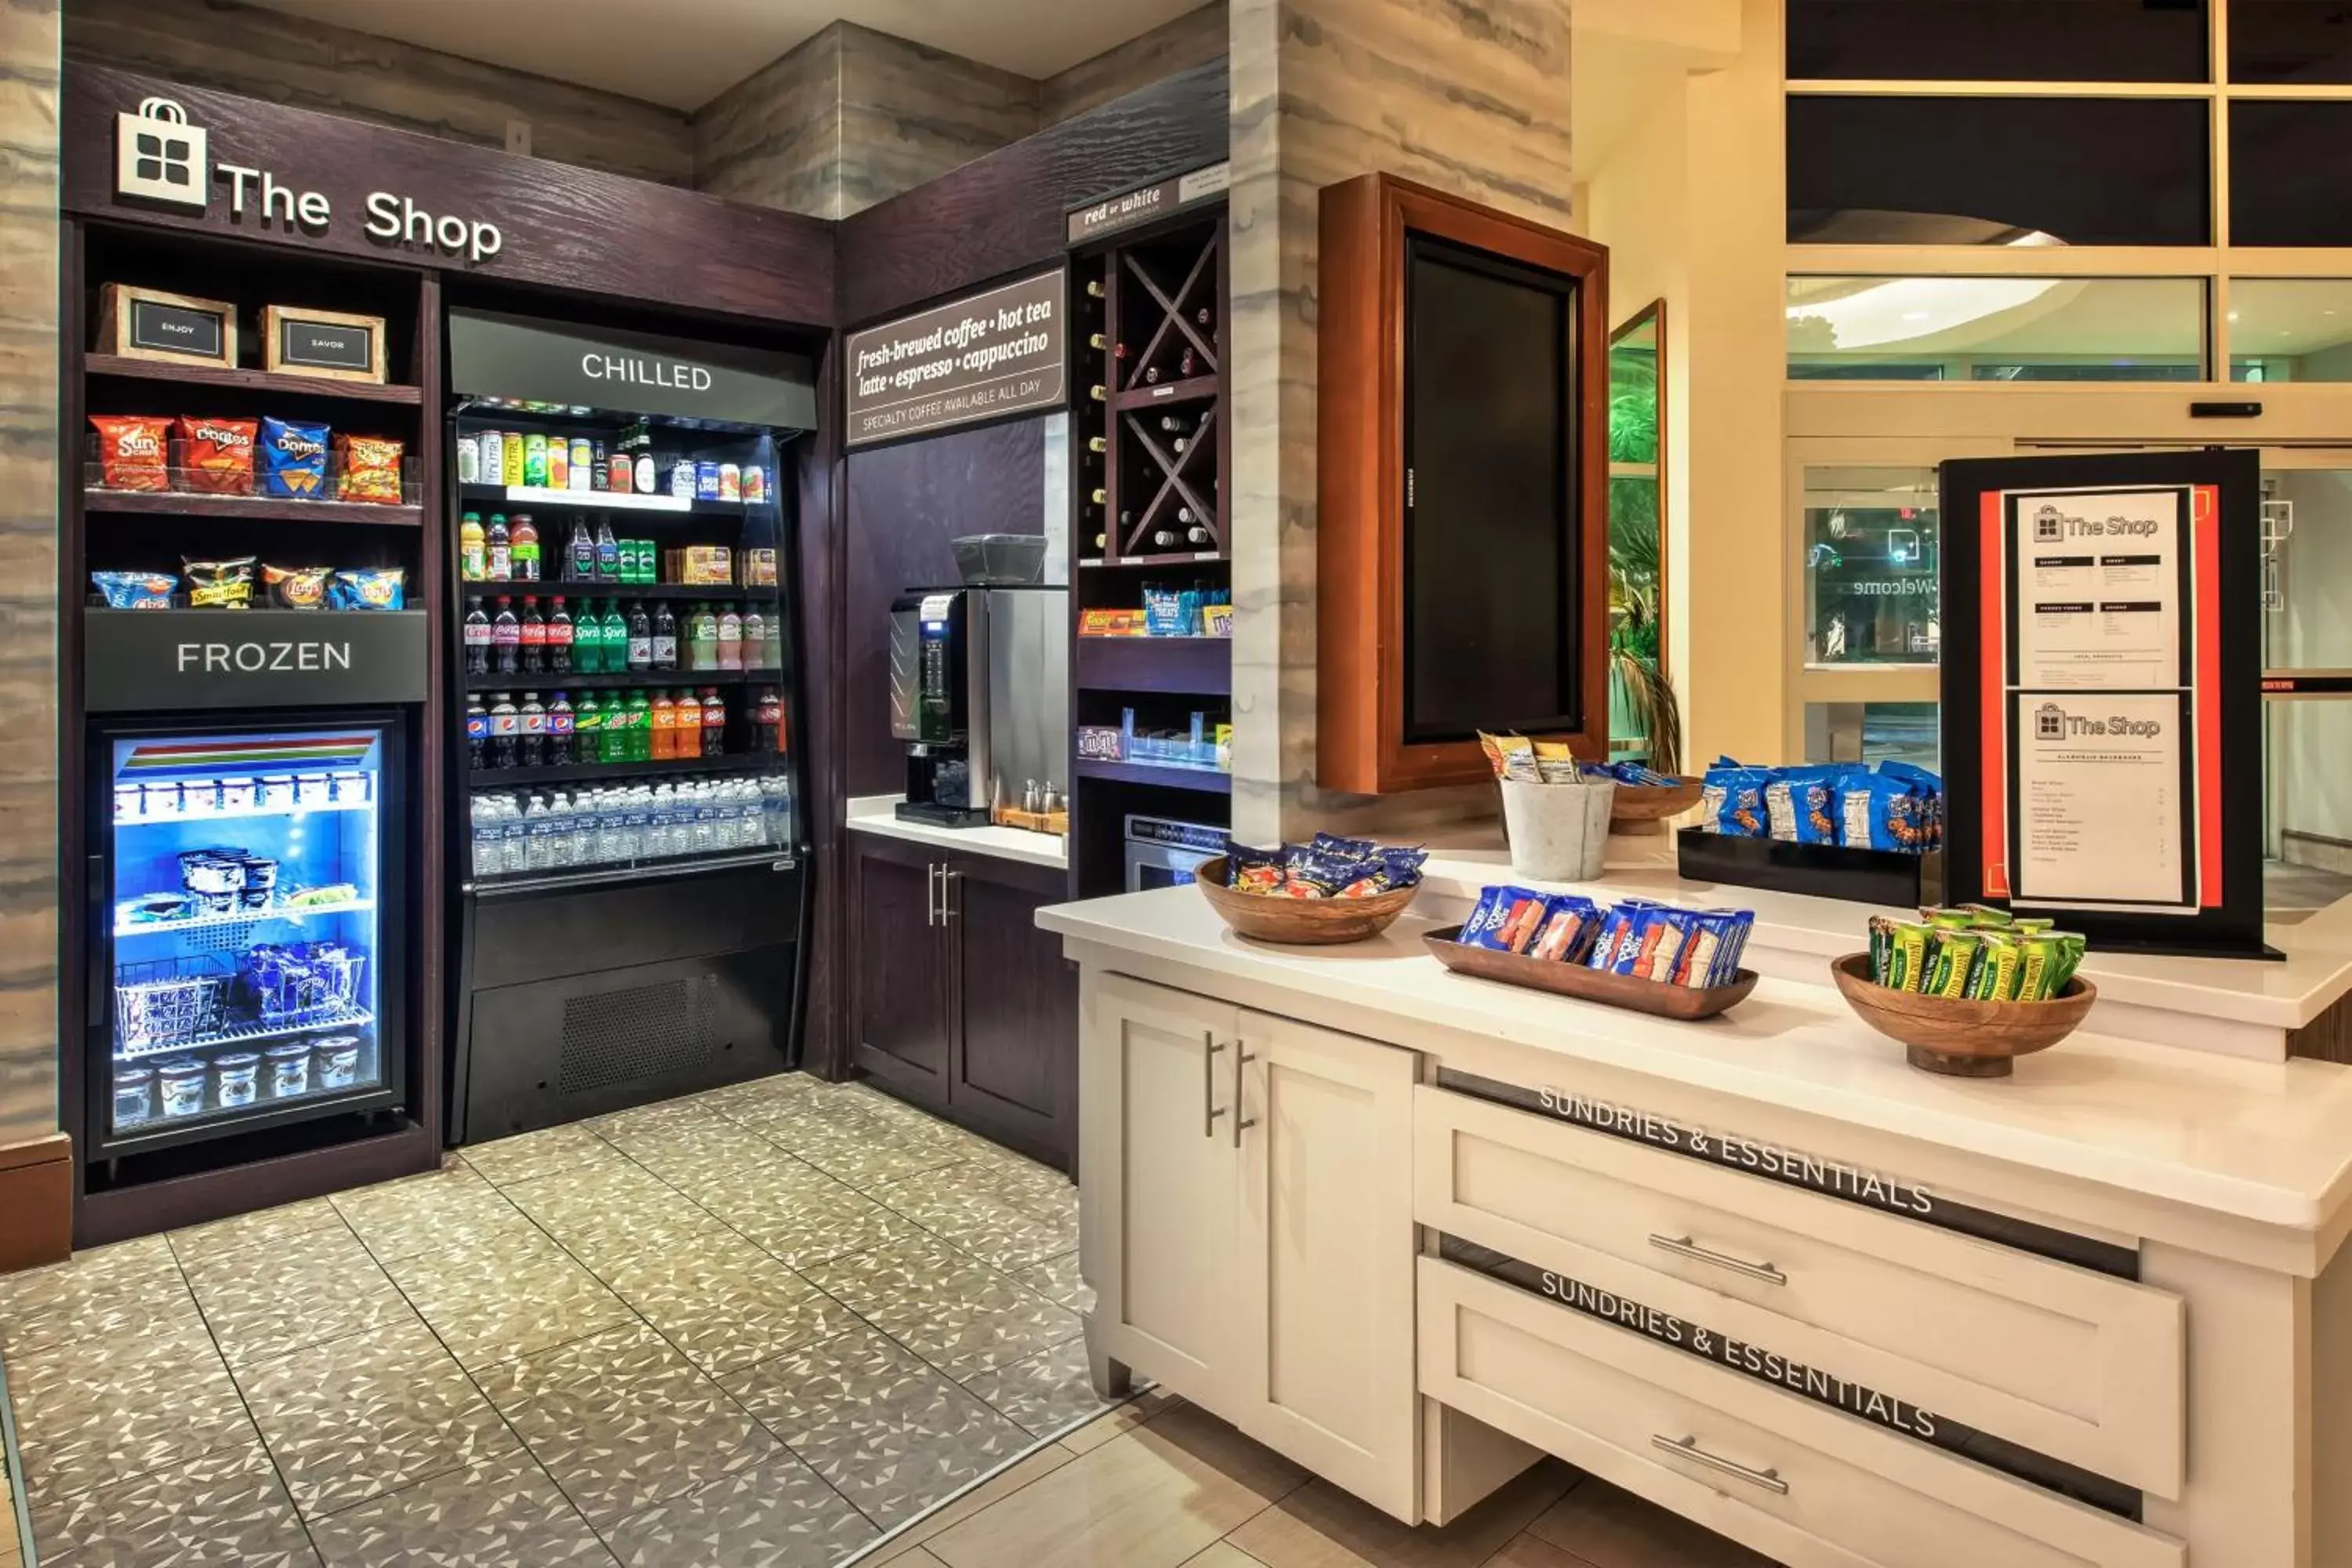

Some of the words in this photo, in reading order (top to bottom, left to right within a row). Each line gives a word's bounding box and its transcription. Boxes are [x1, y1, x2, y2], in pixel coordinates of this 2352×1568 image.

[215, 163, 330, 226] The
[365, 191, 503, 261] Shop
[1084, 203, 1106, 225] red
[1109, 205, 1118, 214] or
[1121, 188, 1161, 213] white
[161, 321, 194, 336] ENJOY
[311, 338, 345, 350] SAVOR
[857, 327, 942, 376] fresh-brewed
[943, 318, 986, 348] coffee
[997, 307, 1023, 332] hot
[1026, 300, 1051, 321] tea
[582, 353, 712, 390] CHILLED
[859, 375, 887, 397] latte
[895, 358, 953, 389] espresso
[963, 332, 1048, 373] cappuccino
[863, 408, 907, 431] SPECIALTY
[909, 401, 941, 421] COFFEE
[945, 389, 995, 412] AVAILABLE
[999, 385, 1017, 402] ALL
[1020, 379, 1041, 396] DAY
[118, 435, 158, 457] Sun
[2065, 517, 2103, 536] The
[2106, 516, 2158, 538] Shop
[177, 641, 351, 672] FROZEN
[2067, 715, 2106, 736] The
[2107, 716, 2161, 739] Shop
[1485, 902, 1503, 931] POP
[1617, 930, 1634, 962] POP
[1540, 1086, 1679, 1145] SUNDRIES
[1690, 1127, 1710, 1155] &
[1722, 1136, 1933, 1214] ESSENTIALS
[1541, 1271, 1682, 1341] SUNDRIES
[1693, 1327, 1713, 1356] &
[1725, 1336, 1936, 1438] ESSENTIALS
